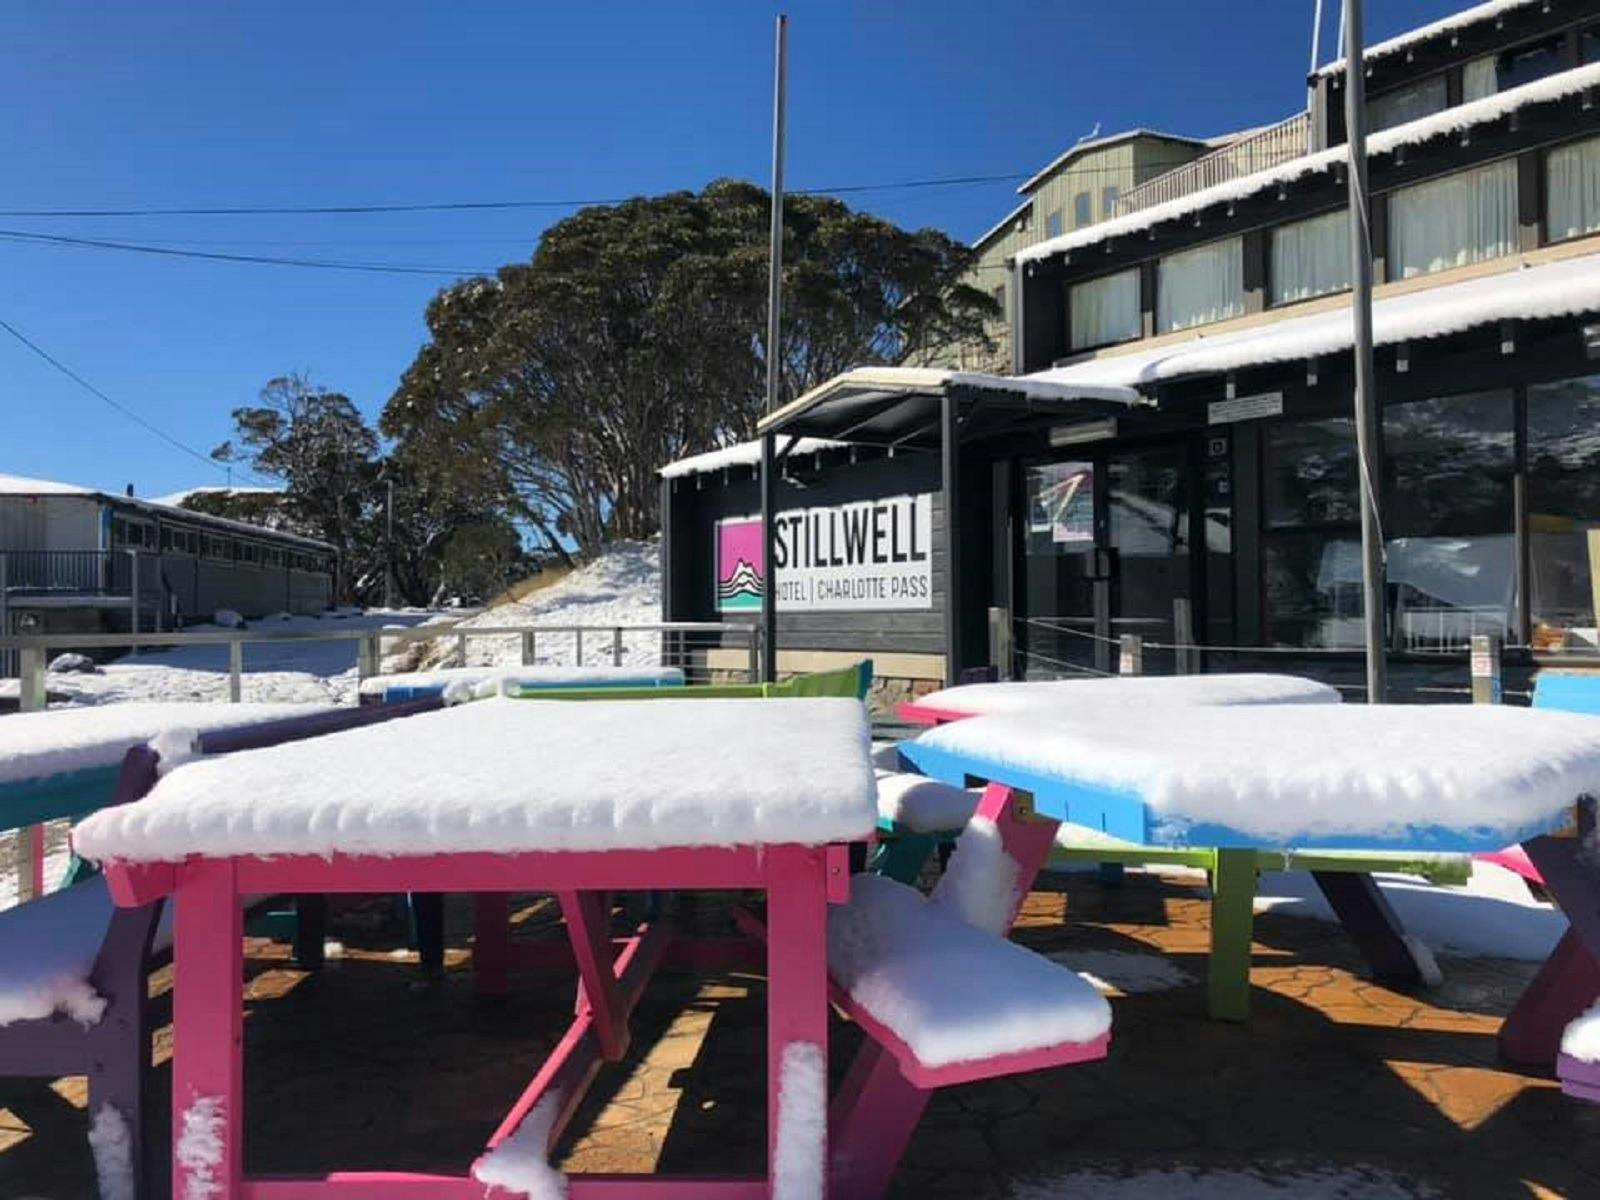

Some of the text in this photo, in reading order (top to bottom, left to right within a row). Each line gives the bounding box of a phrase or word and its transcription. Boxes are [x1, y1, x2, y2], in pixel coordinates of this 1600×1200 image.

[774, 502, 926, 569] STILLWELL
[775, 574, 928, 601] HOTEL CHARLOTTE PASS
